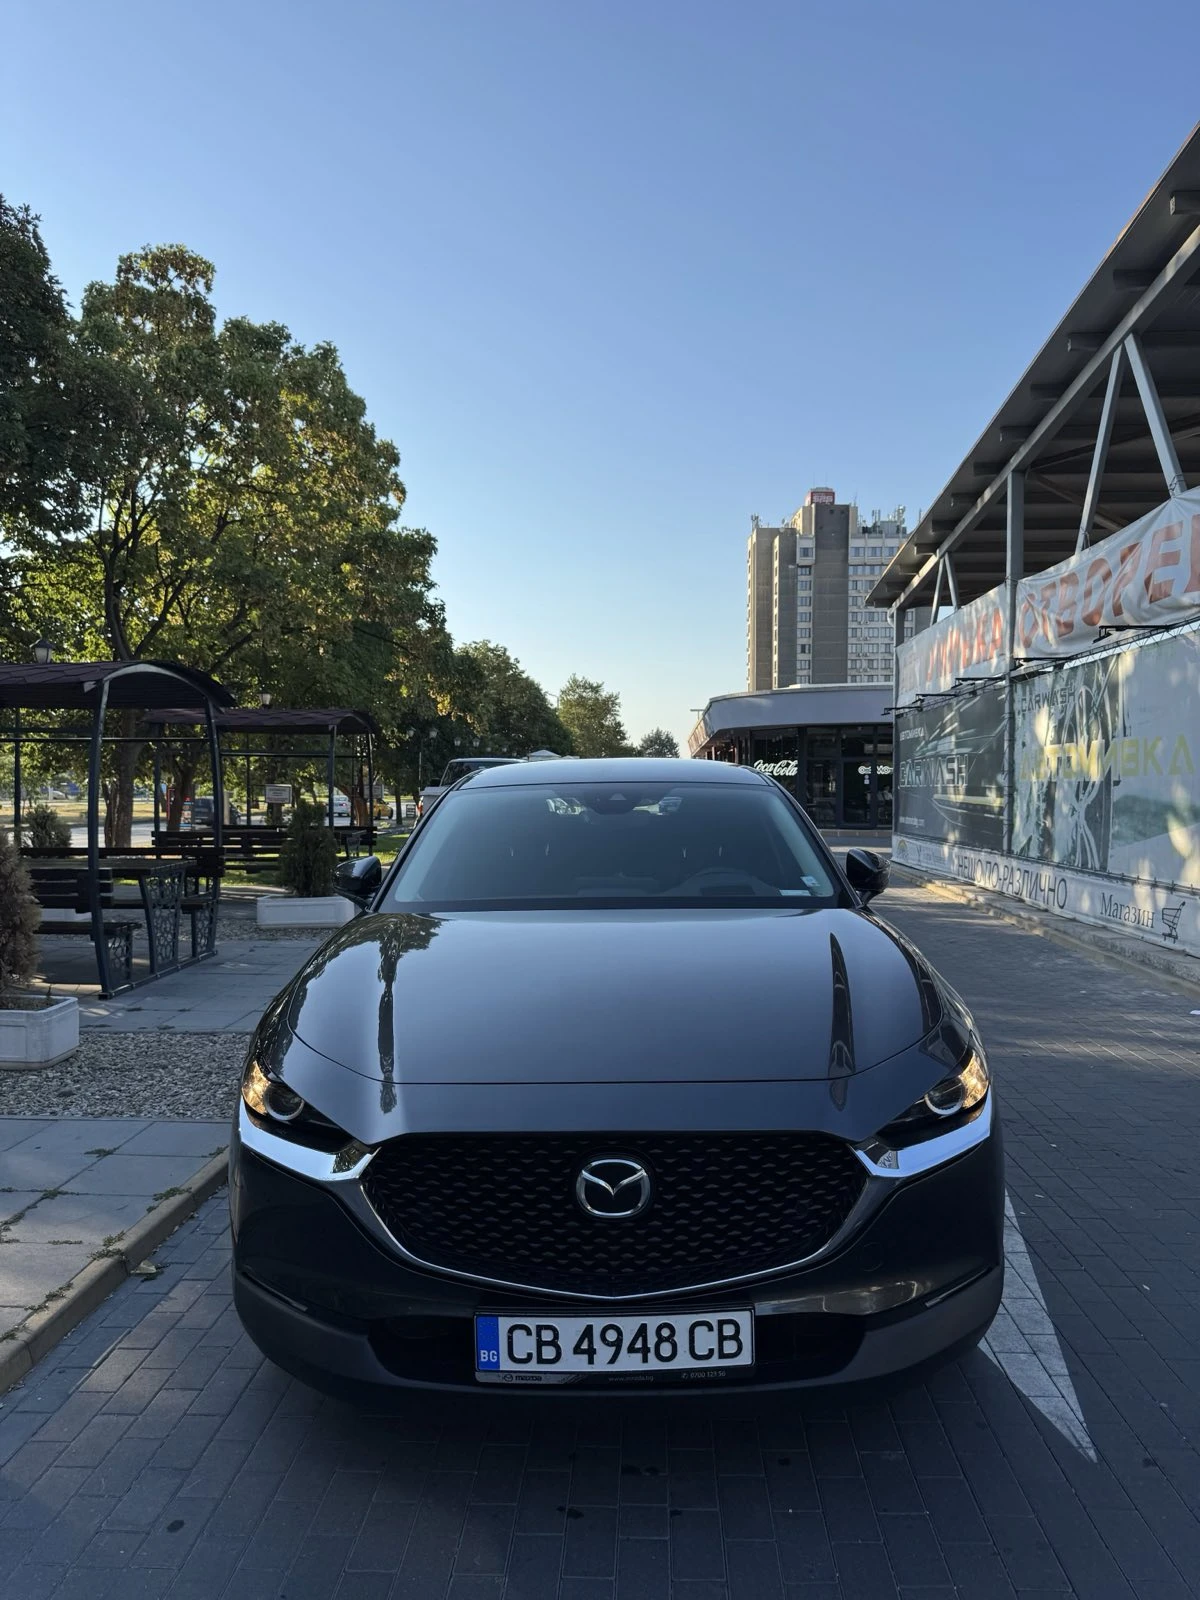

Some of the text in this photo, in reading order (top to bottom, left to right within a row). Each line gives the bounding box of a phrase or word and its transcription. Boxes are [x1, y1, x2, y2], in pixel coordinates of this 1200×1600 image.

[753, 759, 799, 776] Coca-Cola
[899, 753, 969, 788] CARWASH
[1020, 732, 1195, 781] АВТОМИВКА
[985, 860, 1068, 910] ПО-РАЗЛИЧНО
[1100, 892, 1155, 929] Магазин
[480, 1350, 498, 1362] BG
[507, 1318, 744, 1365] CB 4948 CB
